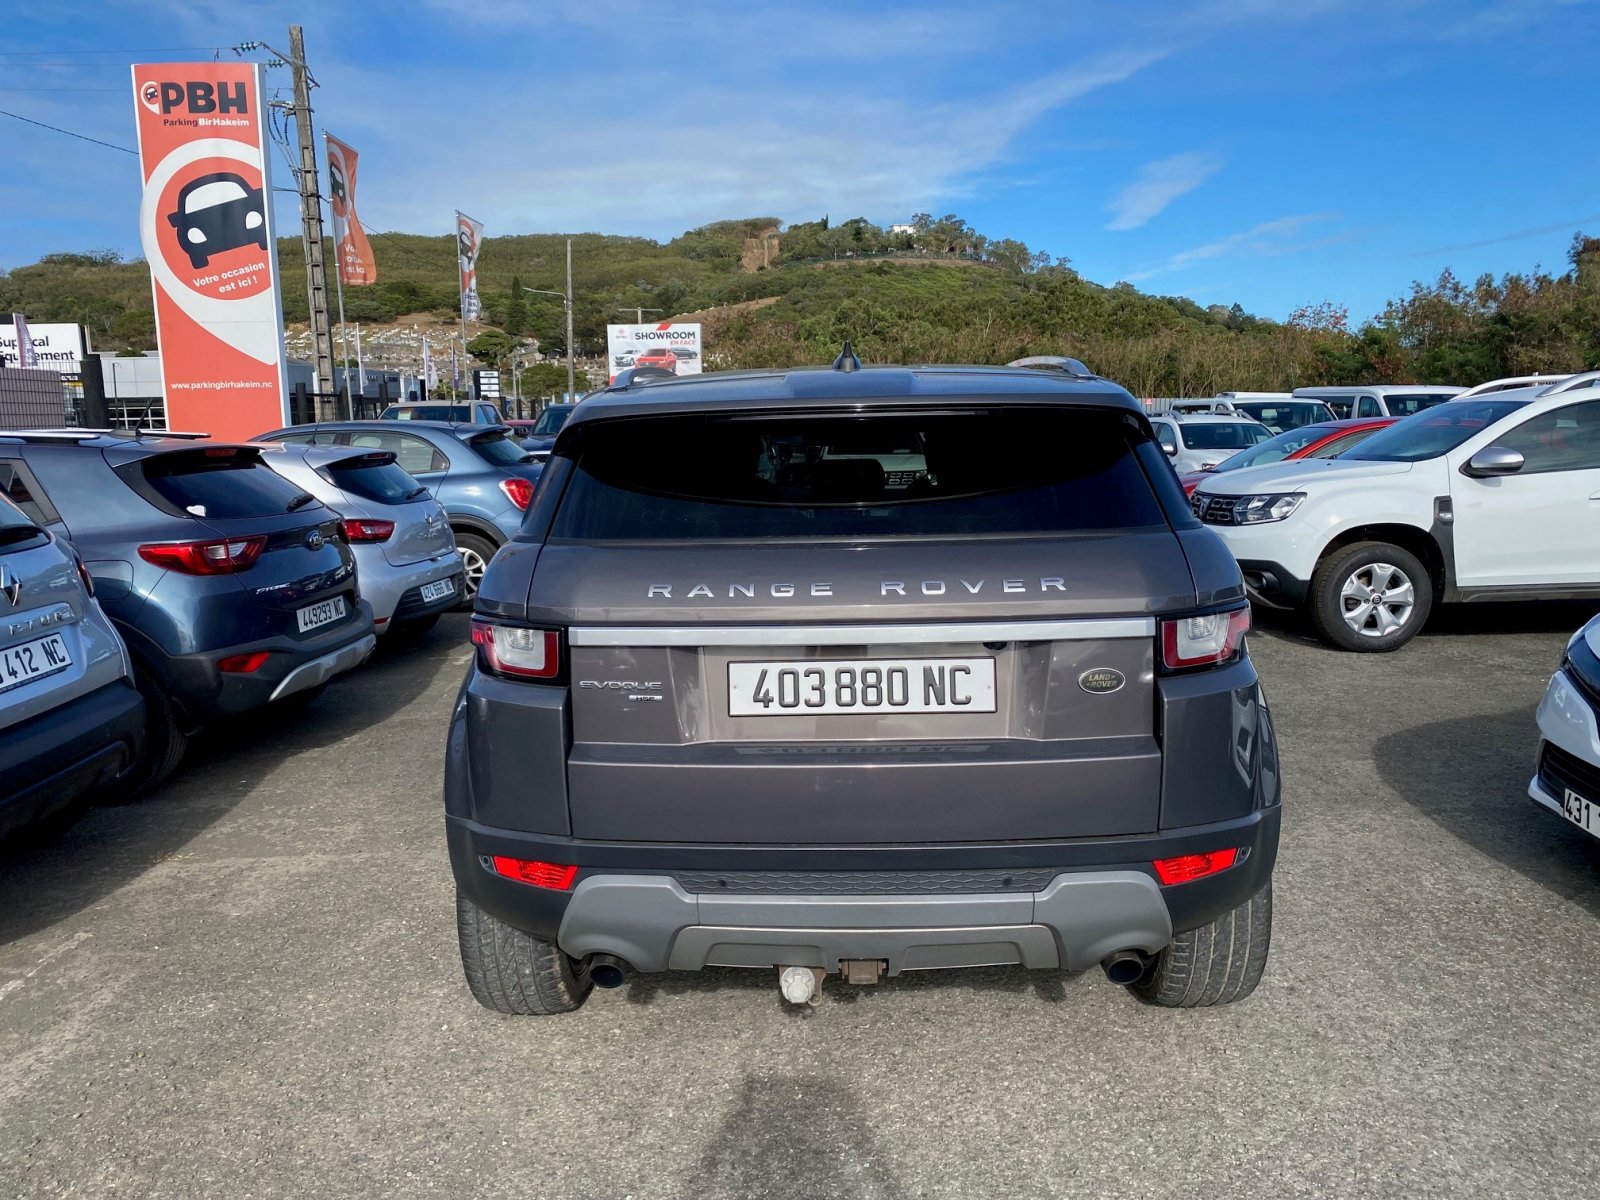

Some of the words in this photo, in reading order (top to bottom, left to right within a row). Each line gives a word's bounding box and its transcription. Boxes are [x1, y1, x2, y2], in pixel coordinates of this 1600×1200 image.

[160, 82, 248, 114] PBH
[193, 275, 218, 287] Votre
[221, 262, 265, 279] occasion
[219, 283, 236, 293] est
[238, 279, 251, 288] ici
[635, 331, 696, 340] SHOWROOM
[171, 381, 273, 391] www.parkingbirhakeim.nc
[647, 582, 833, 598] RANGE
[880, 576, 1067, 596] ROVER
[302, 602, 333, 628] 449293
[40, 638, 66, 667] NC
[579, 680, 662, 690] EVOQUE
[753, 665, 909, 708] 403880
[923, 664, 972, 706] NC
[1565, 792, 1600, 830] 431
